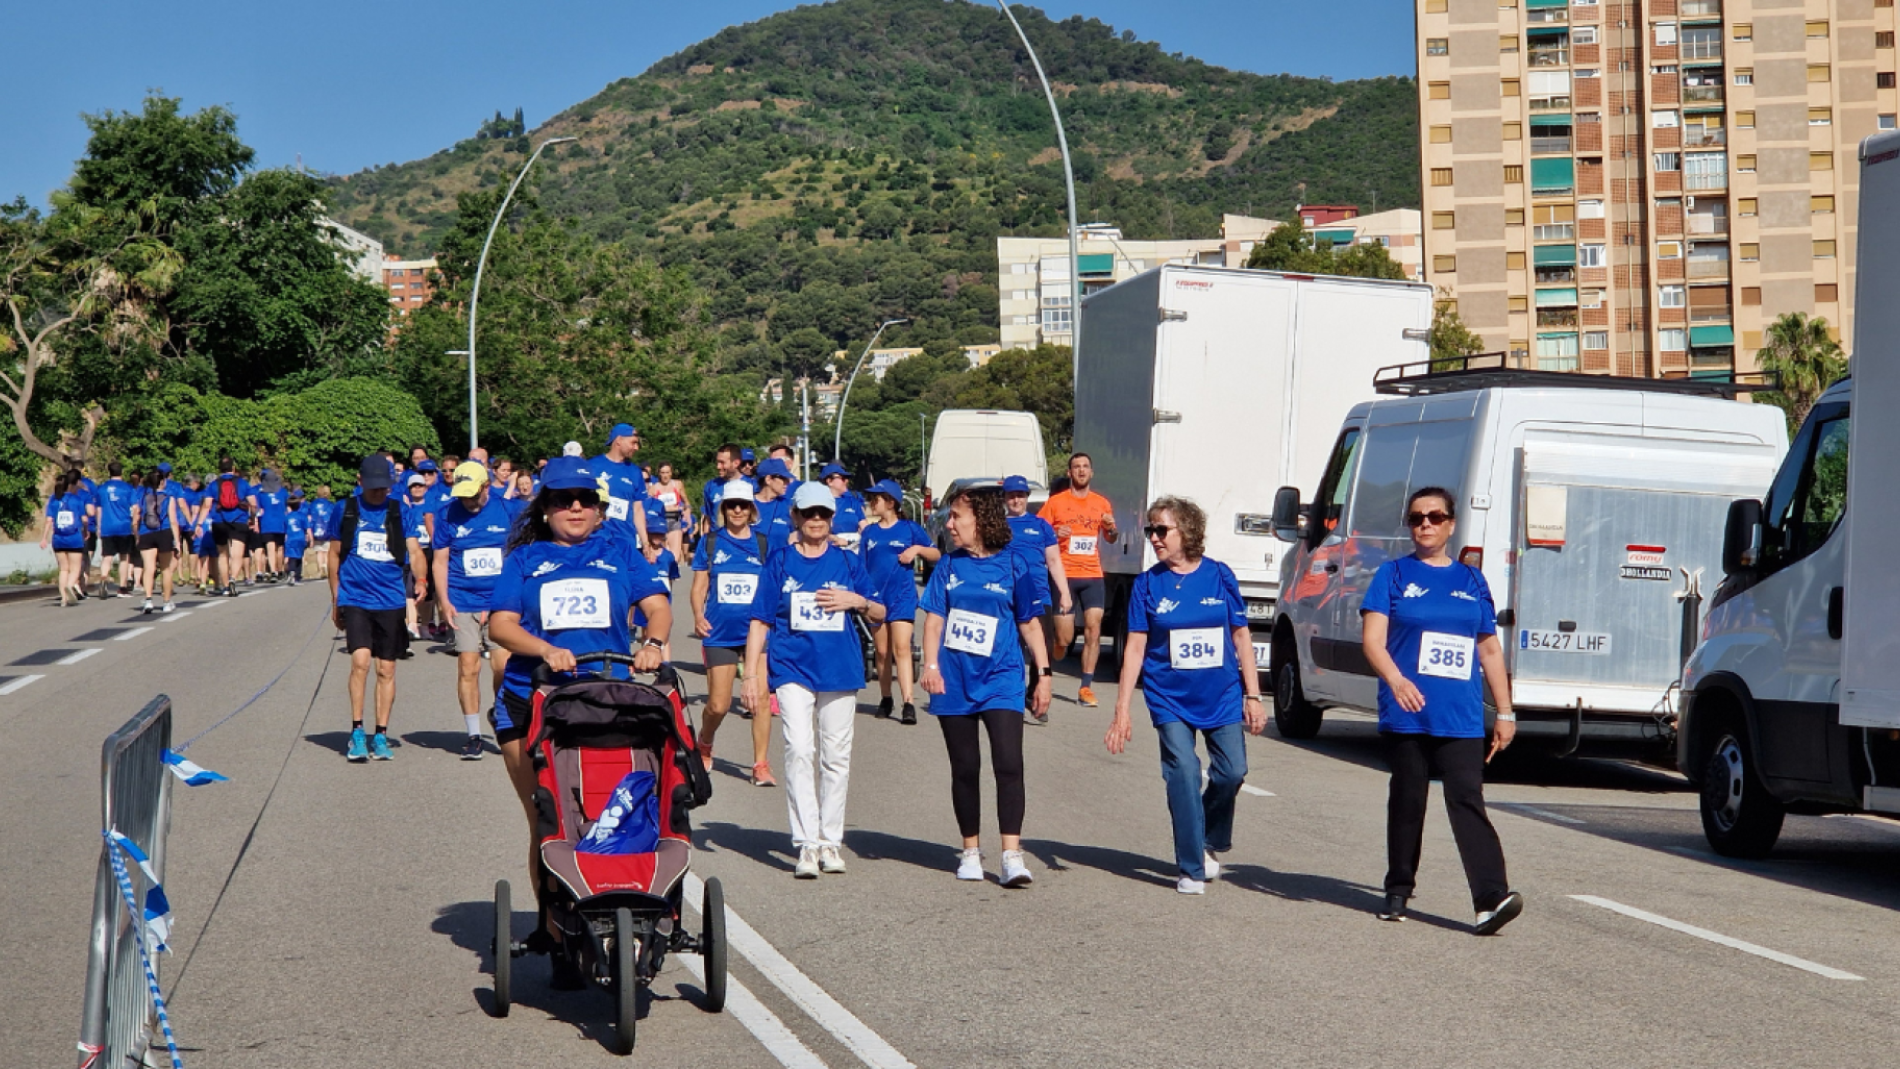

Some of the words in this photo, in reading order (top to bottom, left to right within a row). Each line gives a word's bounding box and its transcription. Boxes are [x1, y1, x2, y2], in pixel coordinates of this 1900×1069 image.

[1074, 541, 1093, 551] 302
[470, 557, 496, 569] 306
[1620, 567, 1671, 579] DHOLLANDIA
[724, 583, 751, 596] 303
[552, 594, 598, 616] 723
[951, 622, 987, 644] 443
[1531, 632, 1571, 650] 5427
[1576, 634, 1607, 651] LHF
[1178, 642, 1216, 659] 384
[1428, 647, 1466, 669] 385
